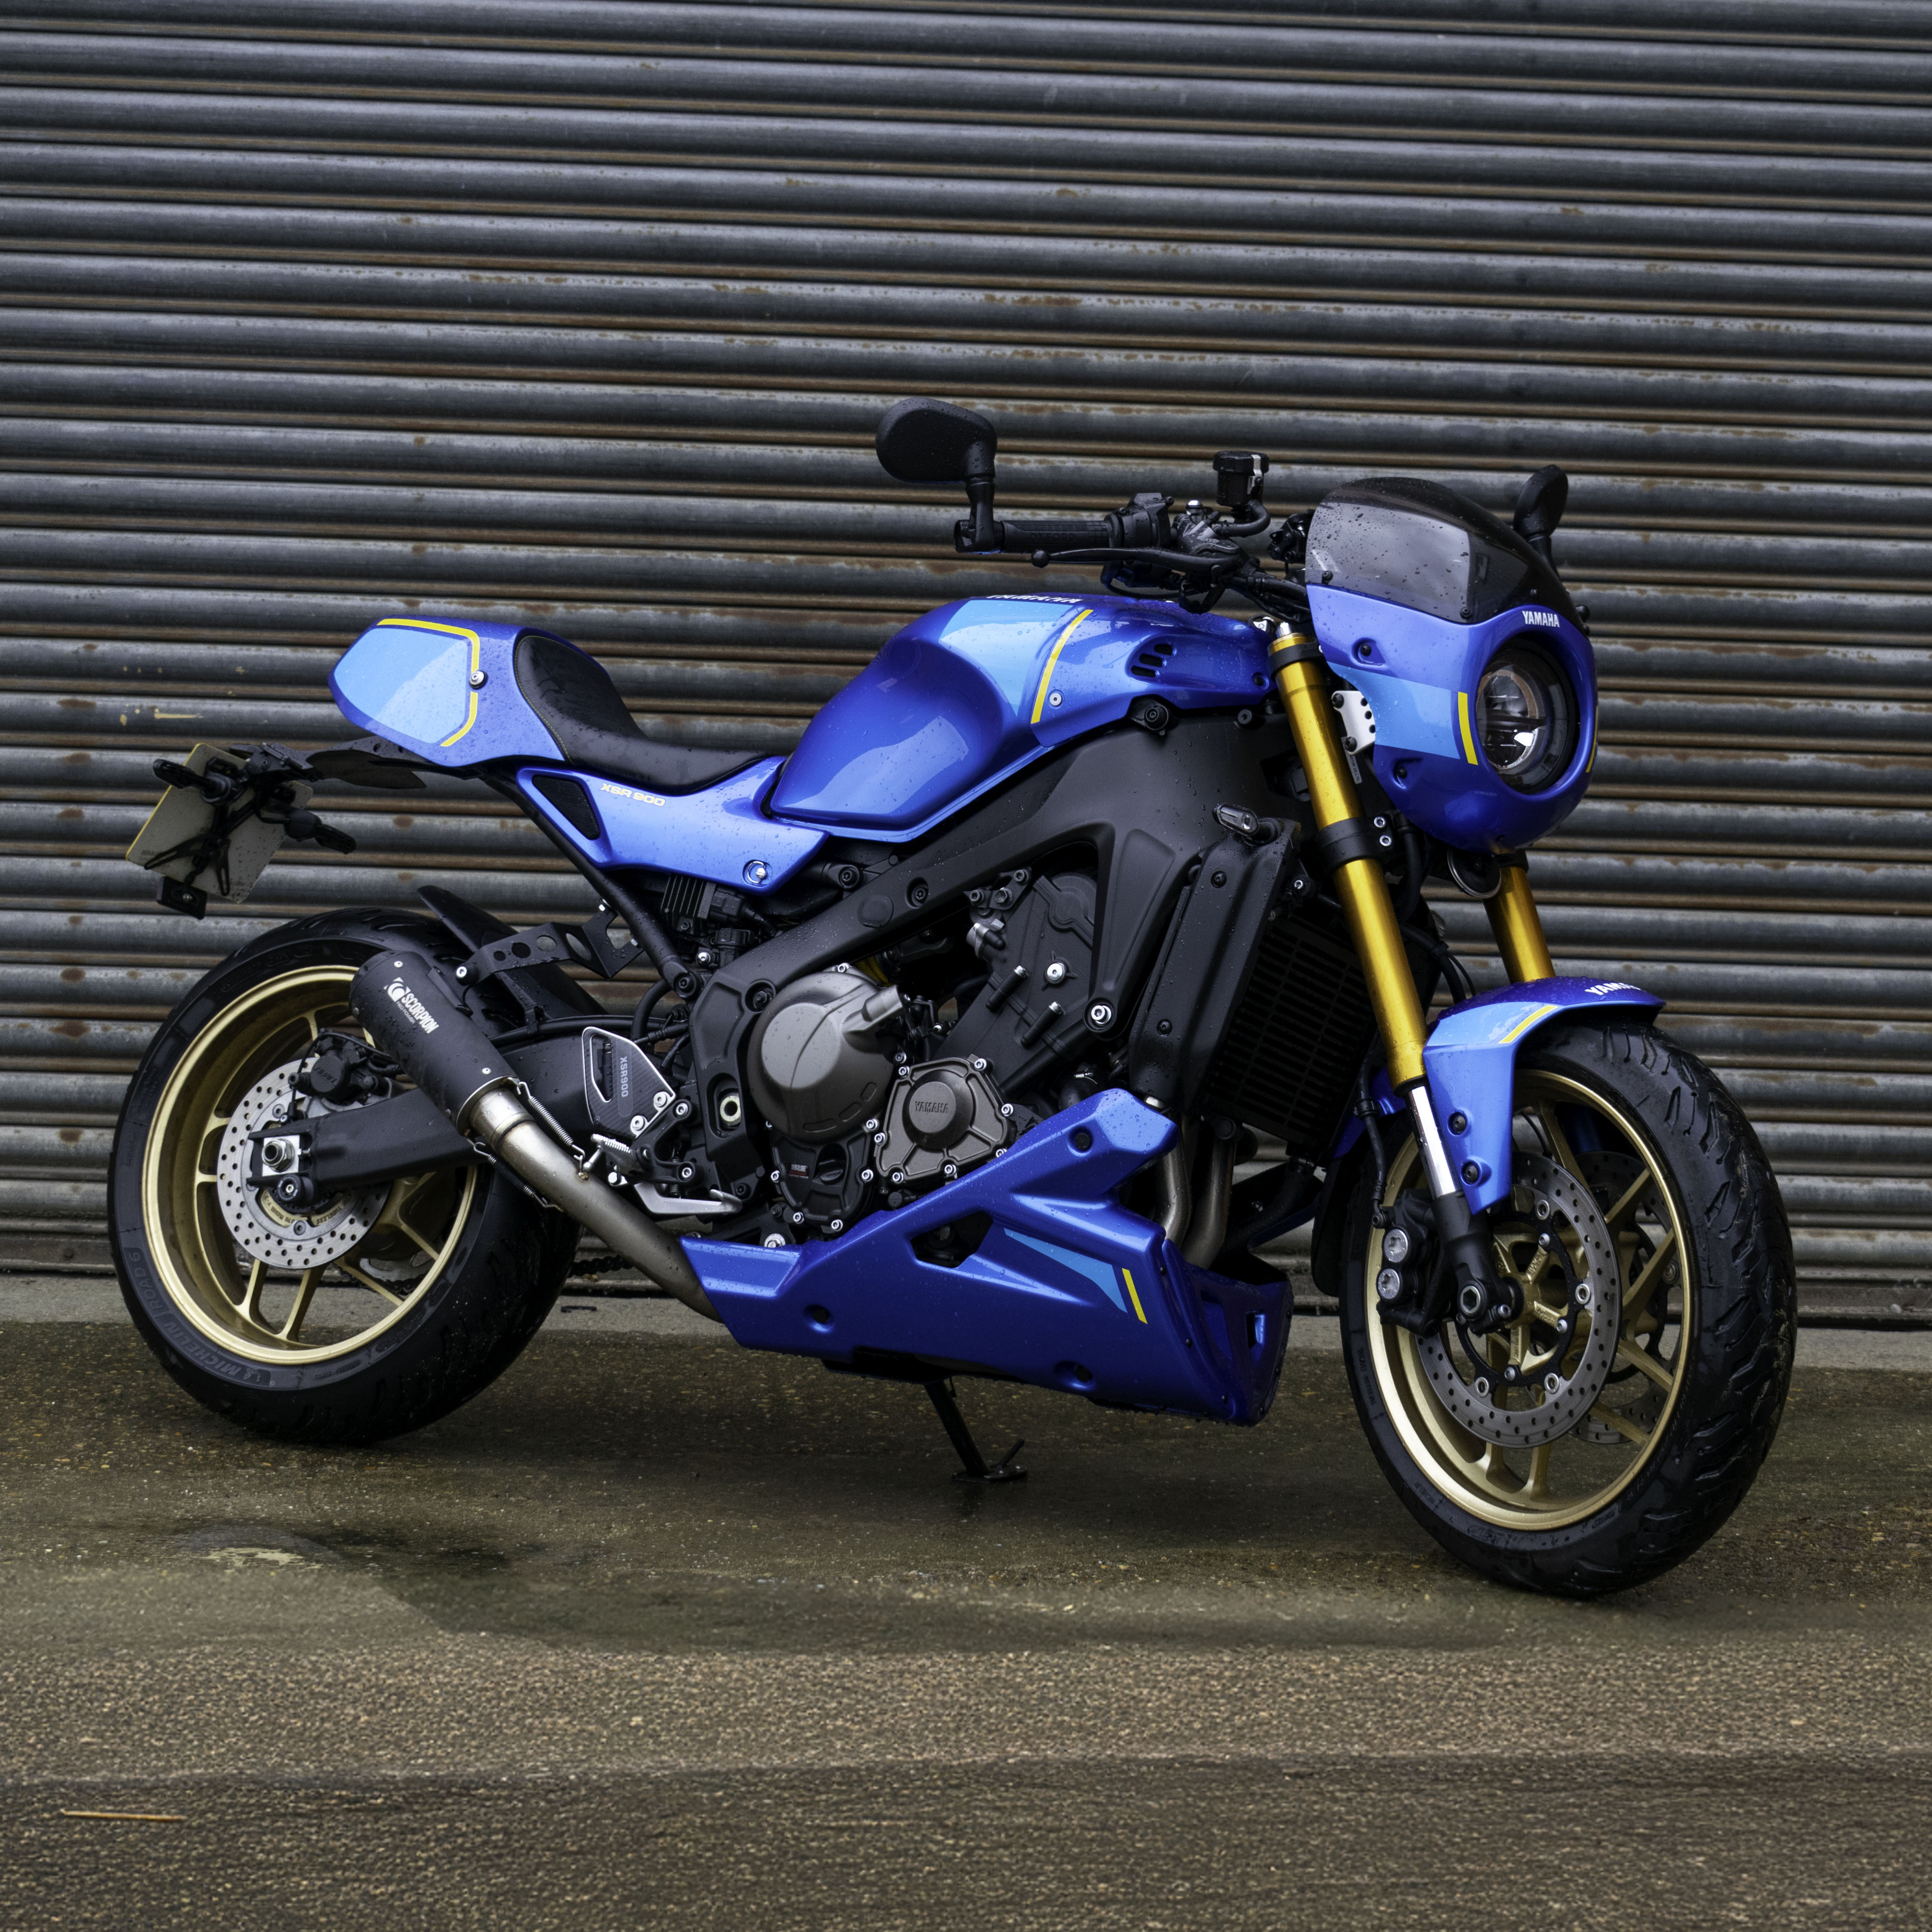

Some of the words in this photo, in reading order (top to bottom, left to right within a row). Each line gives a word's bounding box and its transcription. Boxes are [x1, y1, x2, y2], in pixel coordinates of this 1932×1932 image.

[1522, 610, 1560, 628] YAMAHA
[600, 783, 632, 798] XSR
[633, 792, 666, 806] 900
[401, 993, 439, 1034] SCORPION
[620, 1056, 629, 1097] XSR900
[915, 1101, 949, 1113] YAMAHA
[134, 1268, 163, 1309] ROAD
[163, 1322, 243, 1376] MICHELIN
